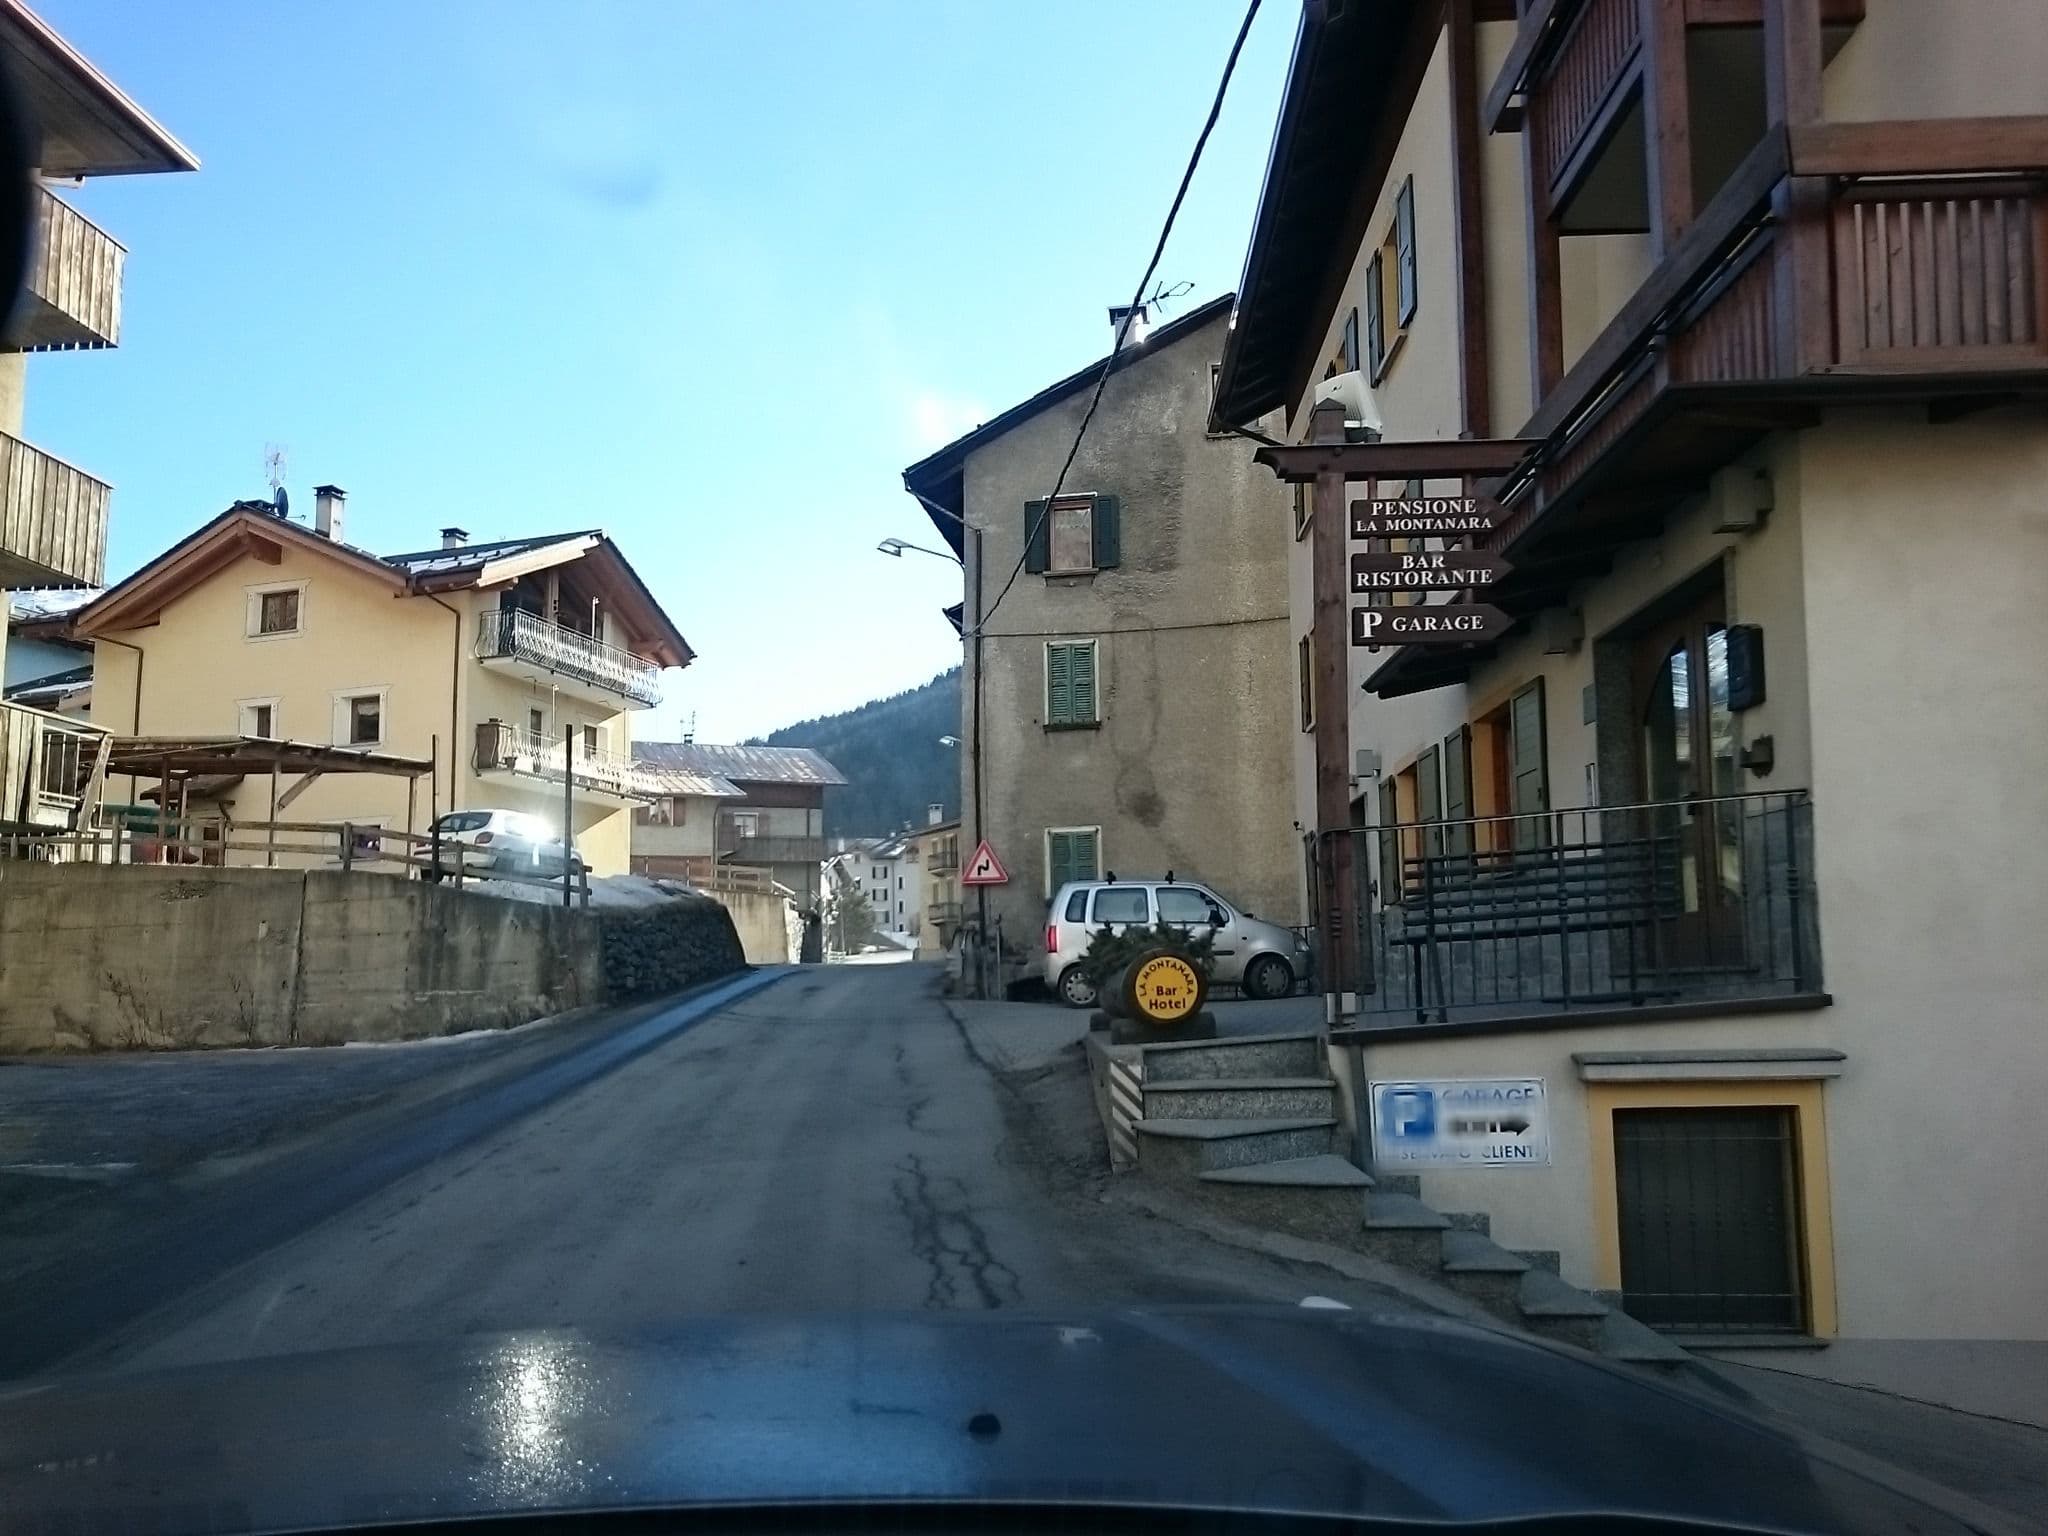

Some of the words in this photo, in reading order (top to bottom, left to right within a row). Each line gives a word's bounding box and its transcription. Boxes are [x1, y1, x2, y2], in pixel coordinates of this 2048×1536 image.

[1371, 500, 1477, 516] PENSIONE
[1355, 520, 1377, 532] LA
[1385, 517, 1493, 532] MONTANARA
[1402, 555, 1446, 569] BAR
[1356, 569, 1492, 587] RISTORANTE
[1360, 611, 1383, 638] P
[1392, 616, 1483, 632] GARAGE
[1139, 983, 1147, 997] LA
[1143, 960, 1194, 995] MONTANARA
[1156, 985, 1177, 996] Bar
[1149, 998, 1186, 1010] Hotel
